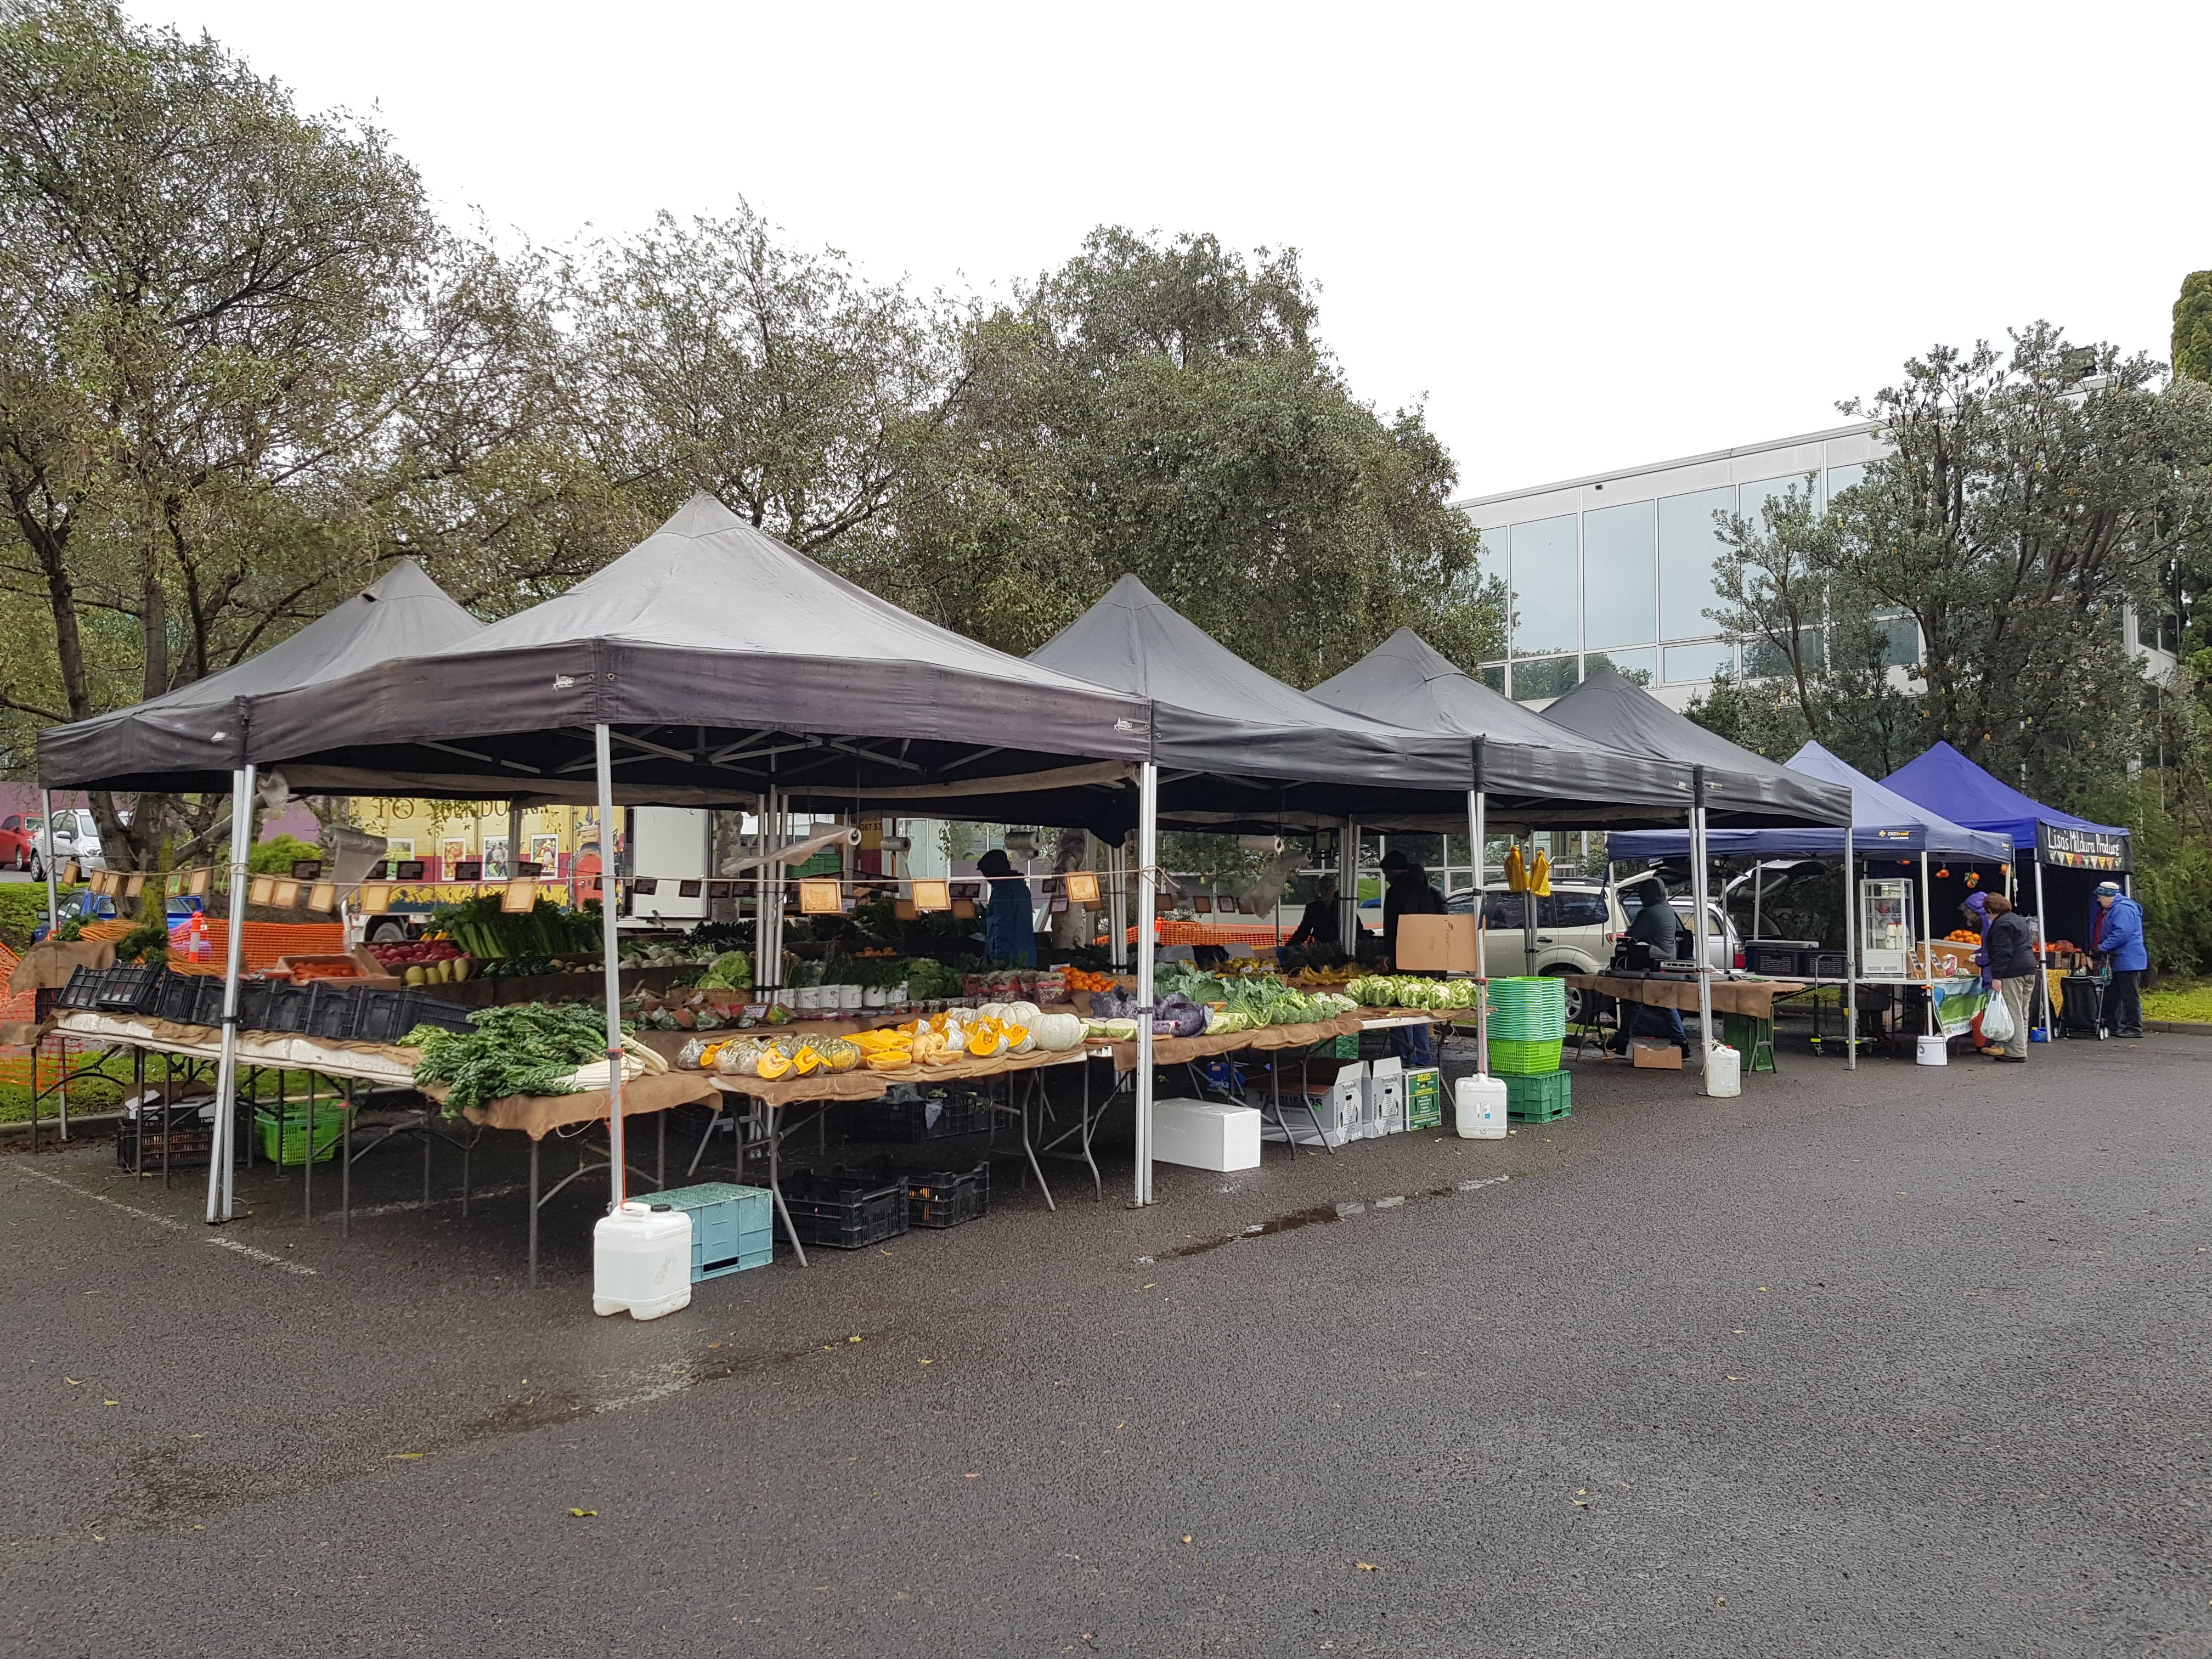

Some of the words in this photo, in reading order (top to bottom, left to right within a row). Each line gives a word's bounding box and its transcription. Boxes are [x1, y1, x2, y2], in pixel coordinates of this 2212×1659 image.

[2047, 826, 2069, 850] Lisa's
[2069, 830, 2095, 853] Mildura
[2096, 833, 2119, 856] Produce
